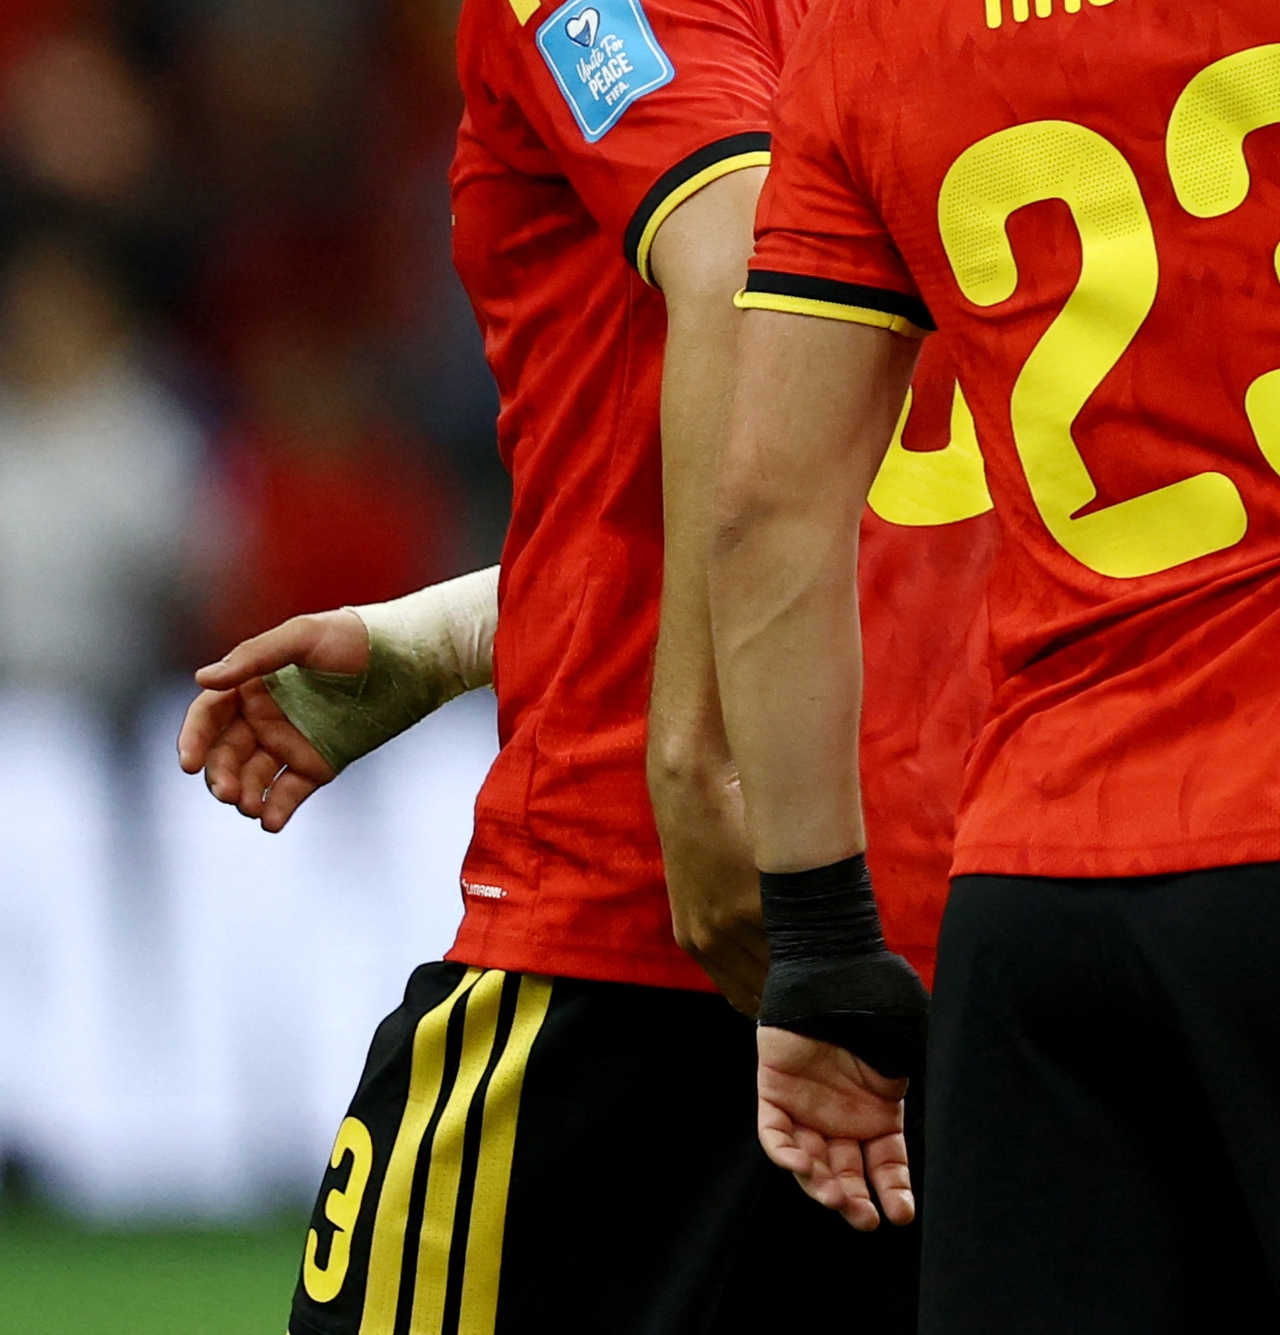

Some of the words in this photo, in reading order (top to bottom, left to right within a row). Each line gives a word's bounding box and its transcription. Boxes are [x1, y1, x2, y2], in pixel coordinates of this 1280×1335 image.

[576, 47, 604, 83] Unite
[600, 34, 624, 58] For
[588, 51, 634, 101] PEACE
[604, 81, 630, 106] FIFA
[303, 1116, 373, 1303] 3
